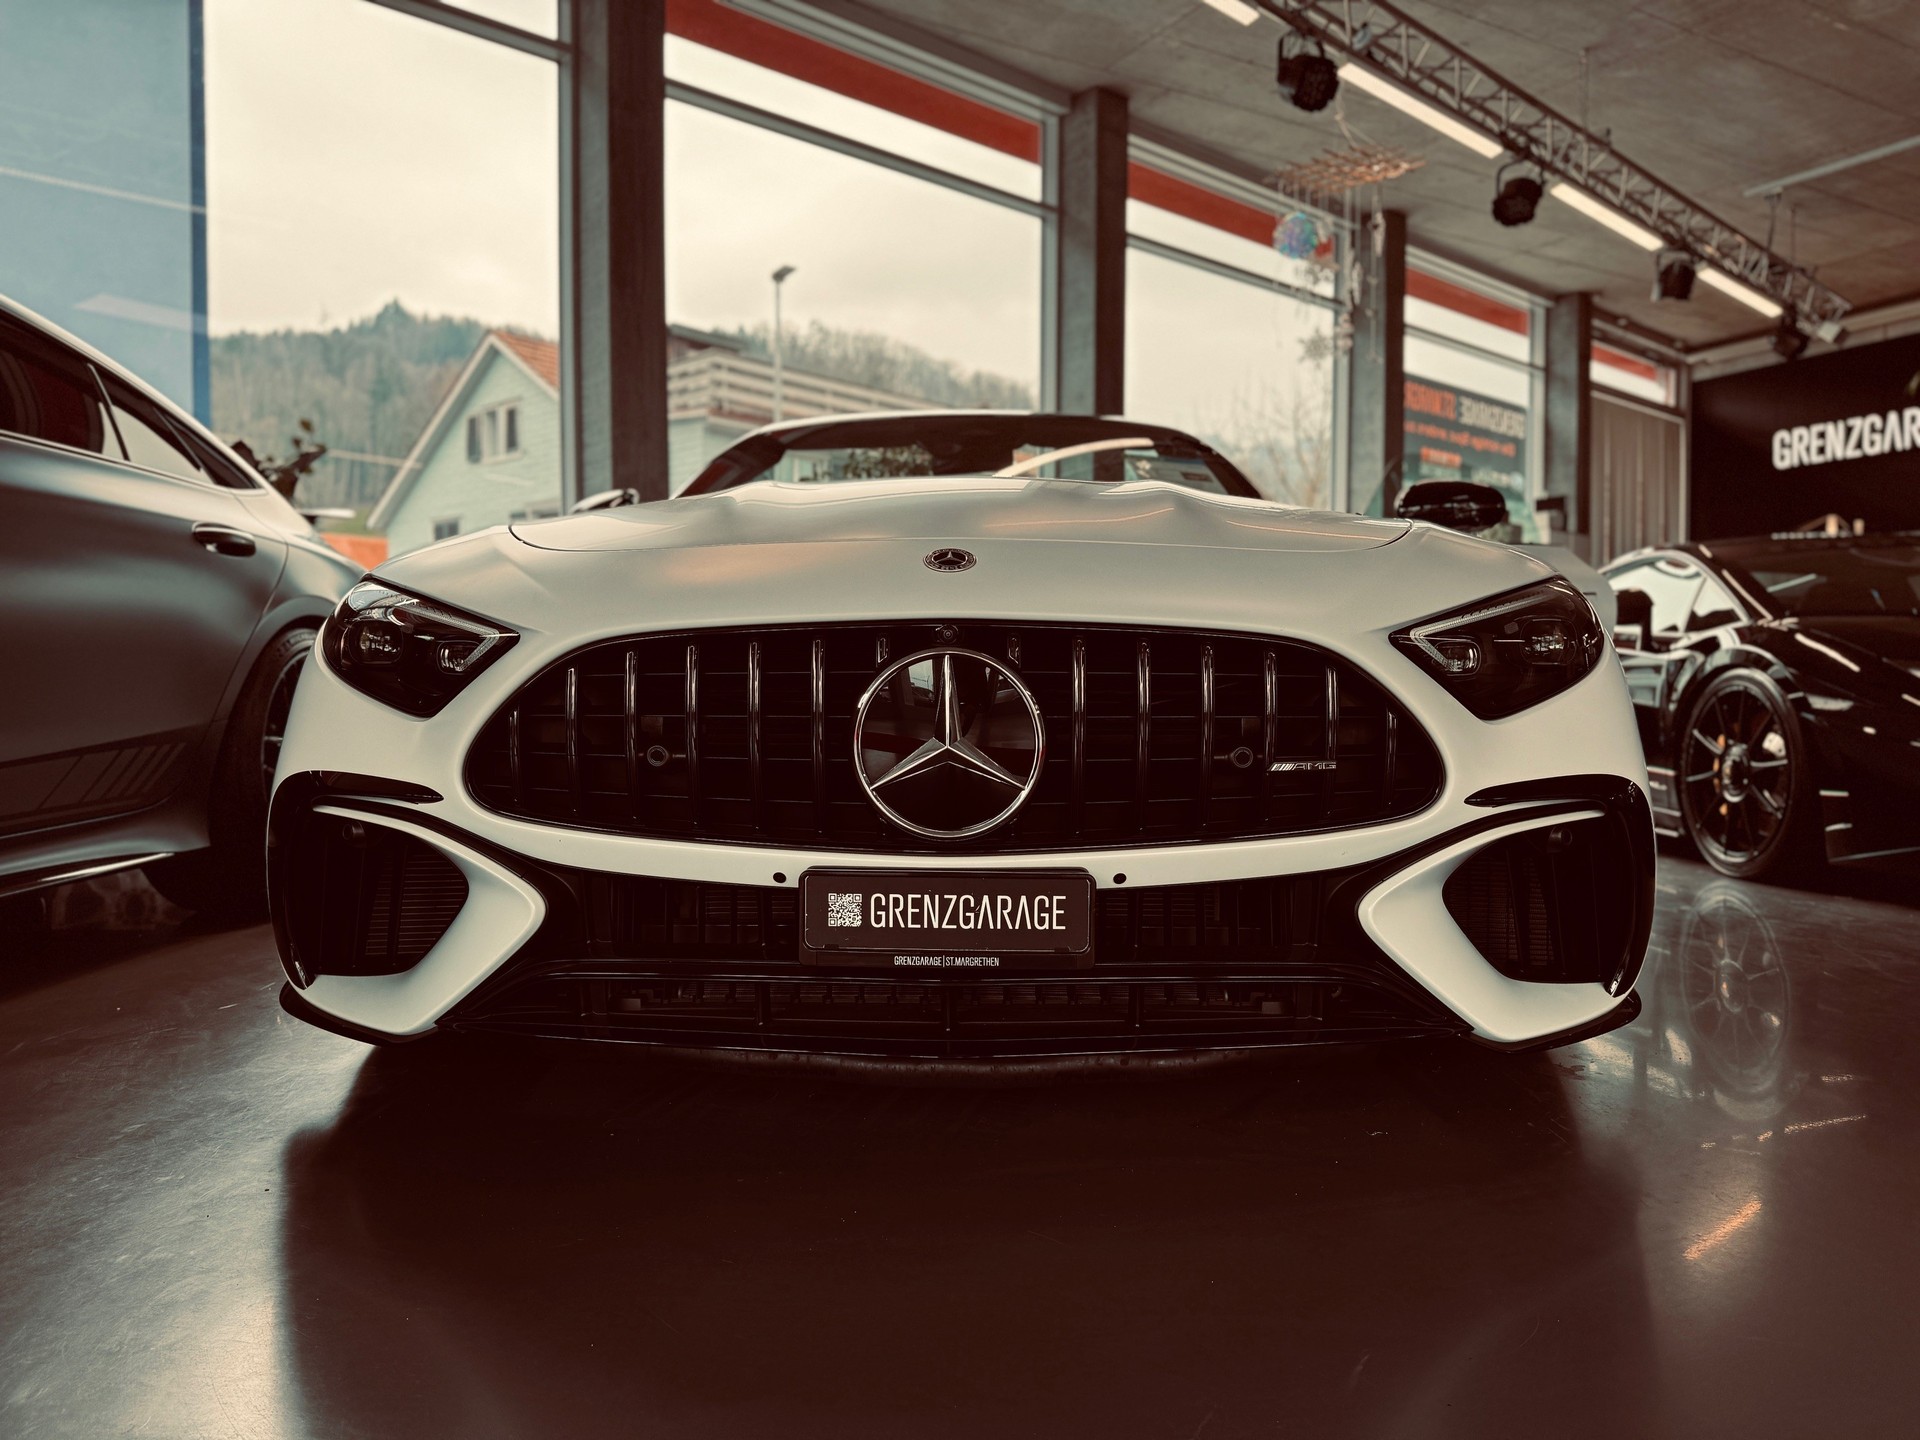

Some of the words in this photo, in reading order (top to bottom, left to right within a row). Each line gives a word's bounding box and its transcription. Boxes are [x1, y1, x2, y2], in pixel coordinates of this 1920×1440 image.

[1772, 406, 1920, 471] GRENZGAR
[1293, 761, 1337, 771] AMG
[870, 893, 1067, 930] GRENZGARAGE
[894, 955, 942, 966] GRENZGARAGE
